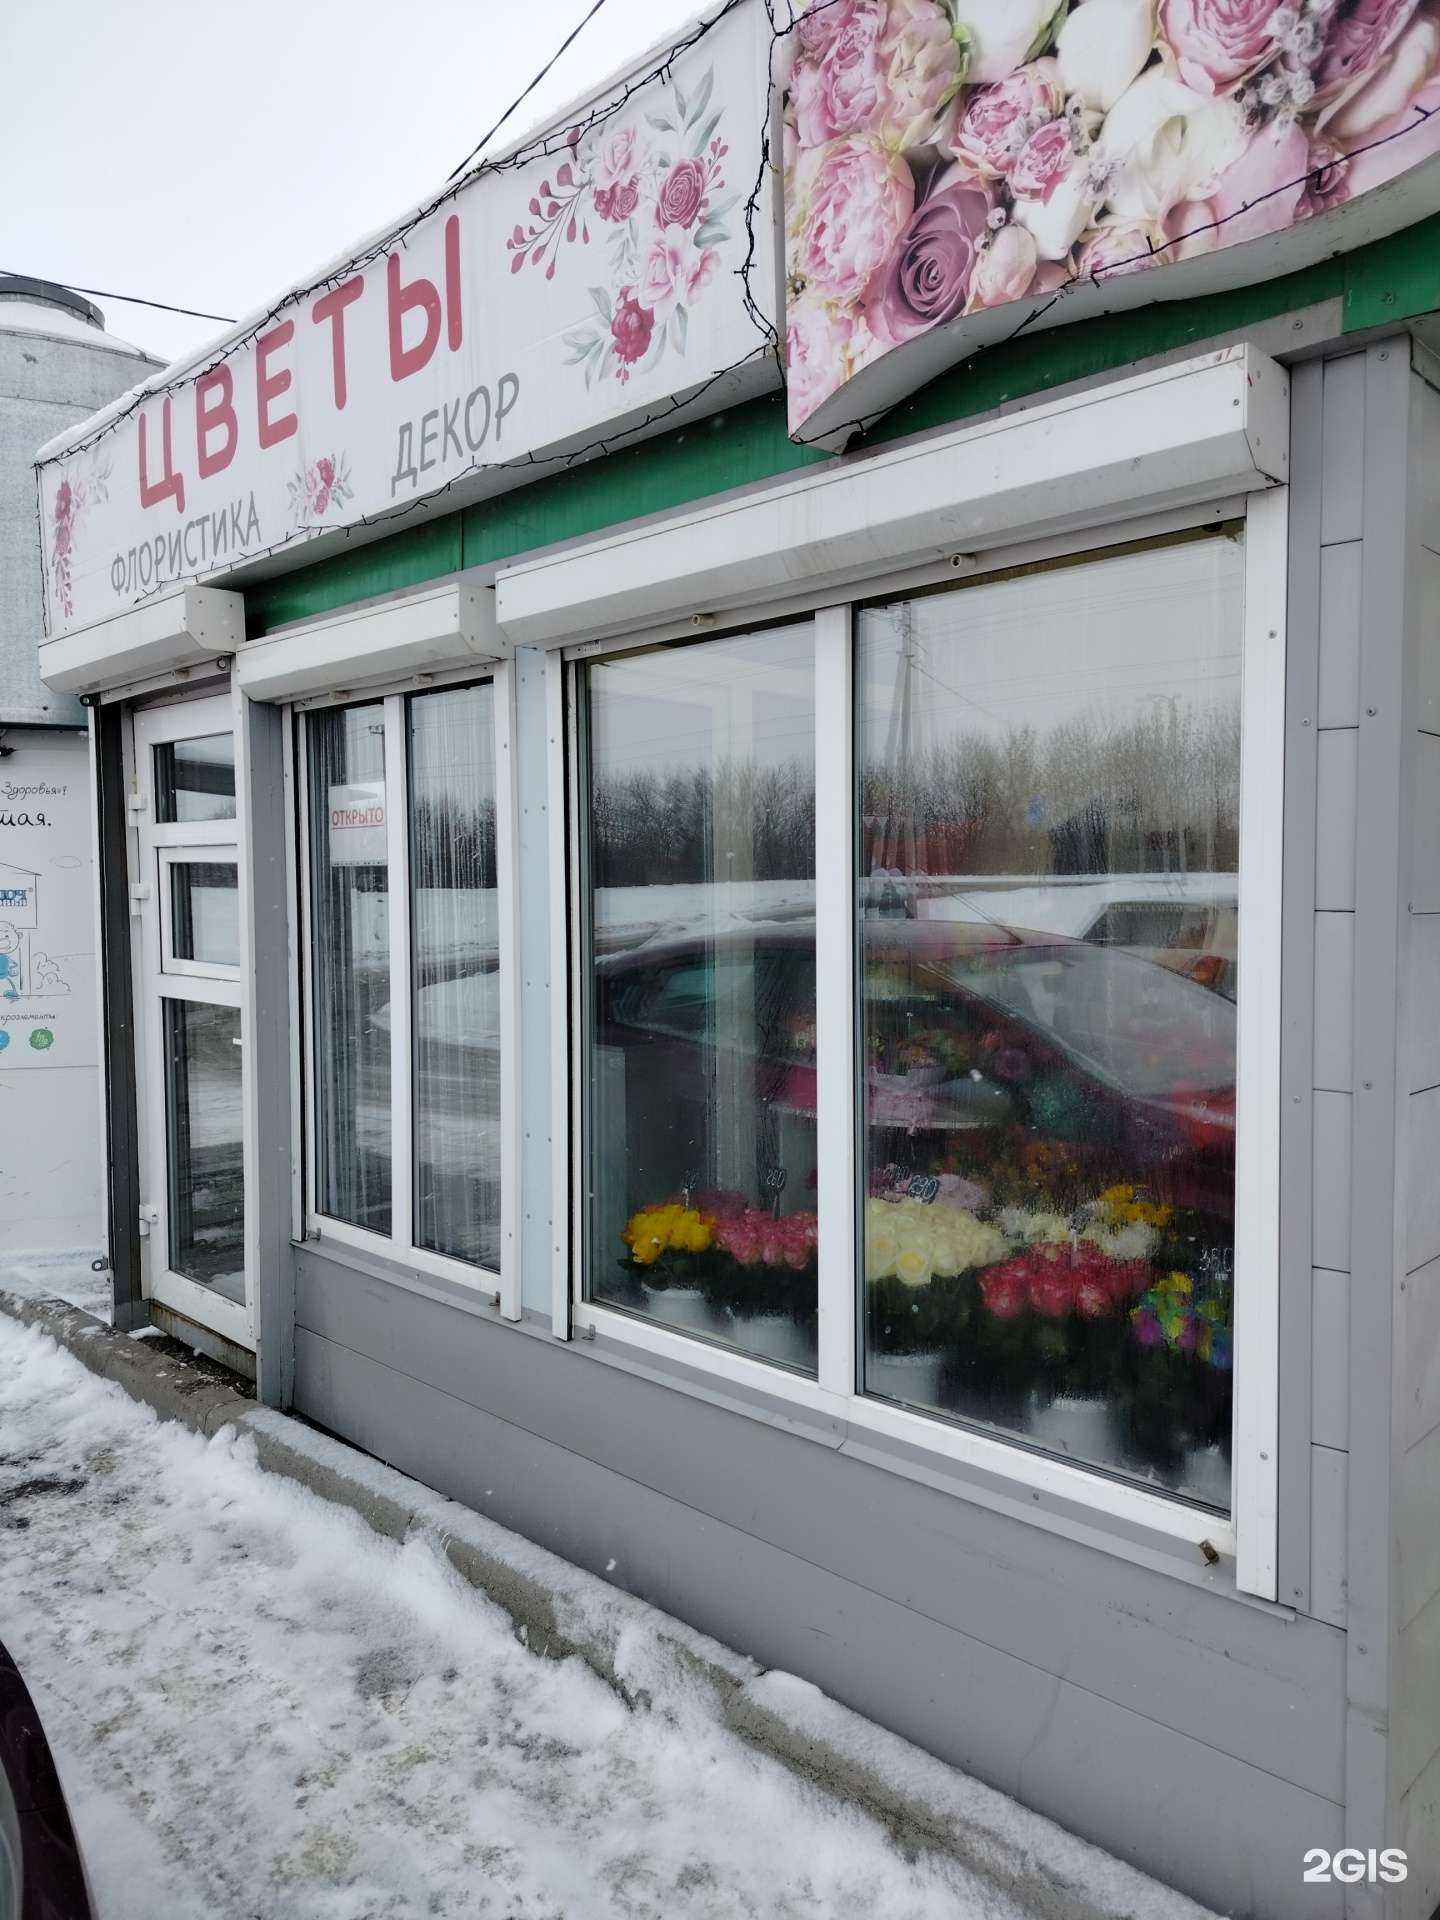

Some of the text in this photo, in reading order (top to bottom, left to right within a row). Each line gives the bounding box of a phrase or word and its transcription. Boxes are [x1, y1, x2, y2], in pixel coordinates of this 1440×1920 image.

[137, 214, 463, 514] ЦВЕТЫ
[391, 372, 520, 498] ДЕКОР
[110, 491, 262, 597] ФЛОРИСТИКА
[331, 807, 384, 826] ОТКРЫТО
